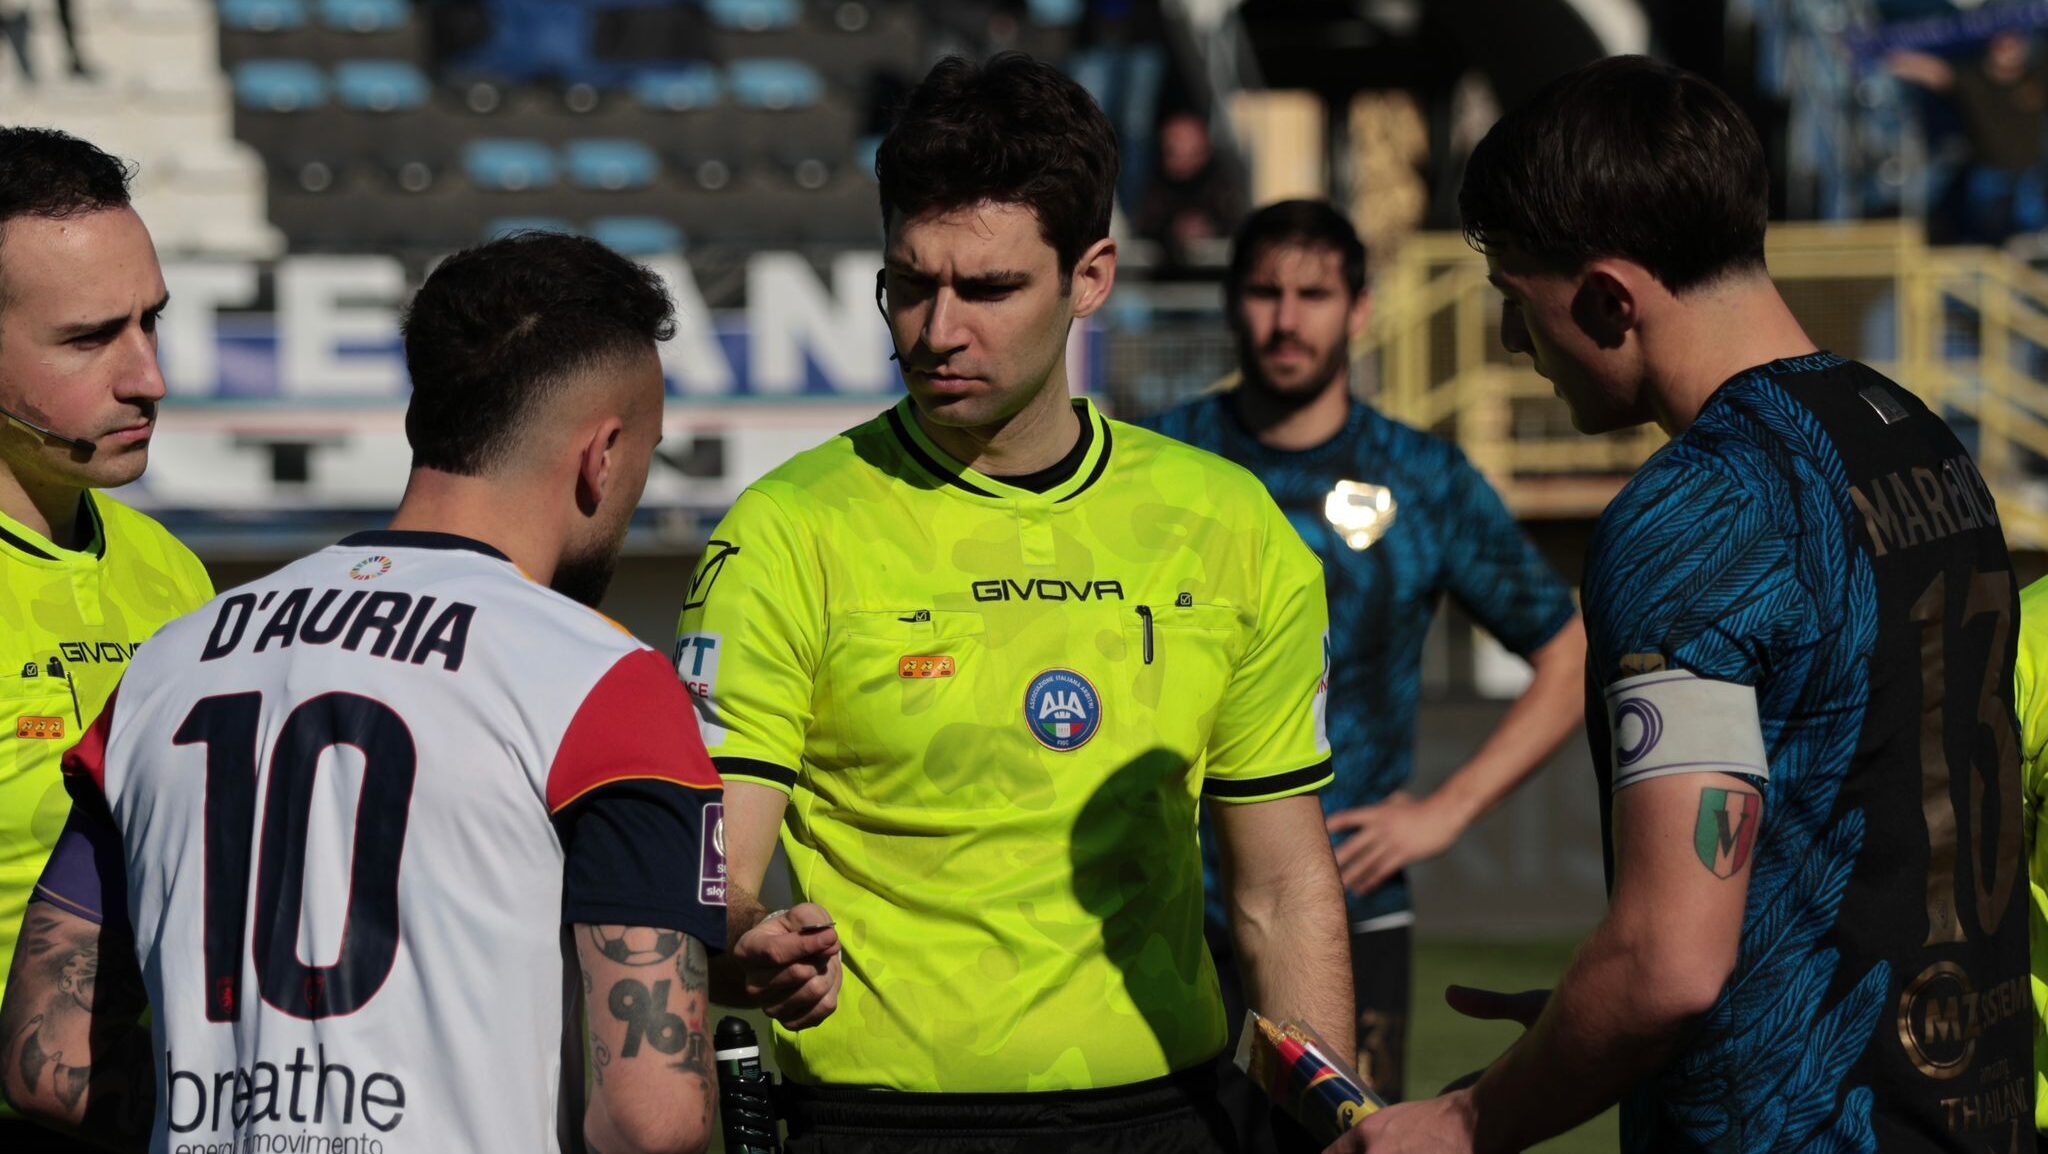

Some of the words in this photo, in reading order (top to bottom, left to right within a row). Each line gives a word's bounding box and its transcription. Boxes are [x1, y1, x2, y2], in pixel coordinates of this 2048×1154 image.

[972, 578, 1125, 603] GIVOVA
[199, 587, 478, 673] D'AURIA
[1038, 690, 1087, 720] AIA
[1712, 809, 1750, 860] V
[171, 690, 417, 1023] 10
[705, 885, 726, 898] sky
[166, 1042, 406, 1134] breathe
[253, 1128, 384, 1154] movimento
